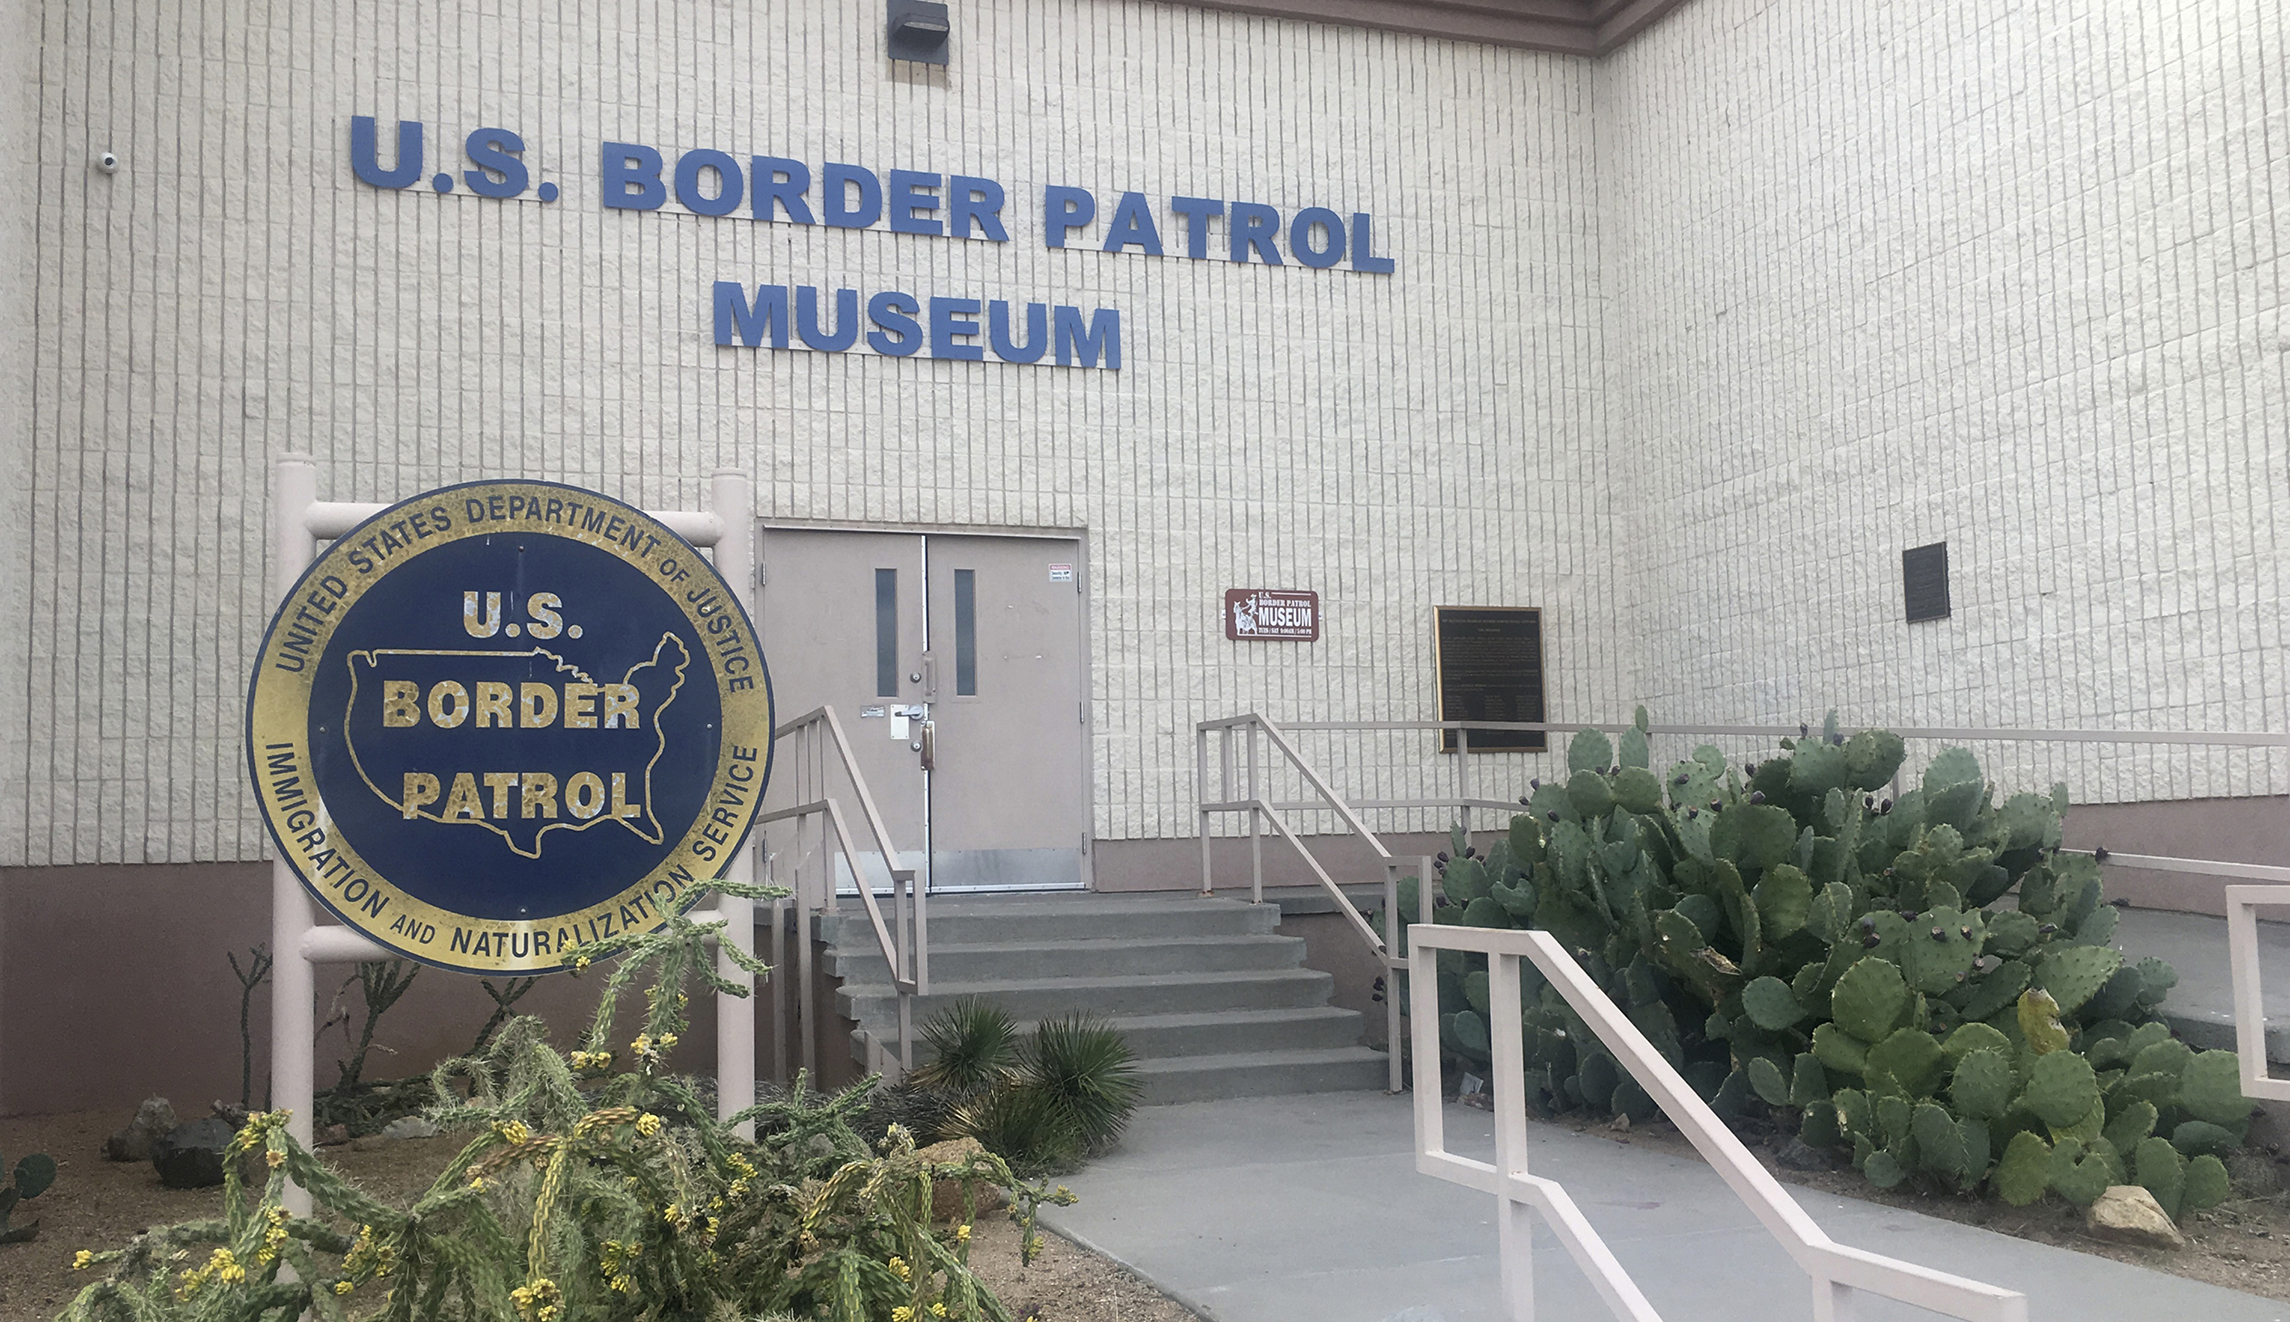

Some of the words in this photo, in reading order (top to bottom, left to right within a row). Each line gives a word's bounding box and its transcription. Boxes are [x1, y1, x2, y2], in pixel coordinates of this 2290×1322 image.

[351, 115, 559, 203] U.S.
[603, 141, 1010, 242] BORDER
[1045, 185, 1395, 274] PATROL
[713, 280, 1121, 370] MUSEUM
[275, 574, 348, 673] UNITED
[348, 506, 452, 574] STATES
[465, 495, 661, 559] DEPARTMENT
[659, 558, 690, 584] OF
[687, 587, 754, 693] JUSTICE
[463, 590, 584, 640] U.S.
[1258, 591, 1271, 599] U.S.
[1258, 599, 1285, 607] BORDER
[1287, 600, 1311, 608] PATROL
[1258, 607, 1312, 627] MUSEUM
[383, 680, 640, 729] BORDER
[403, 771, 641, 819] PATROL
[266, 742, 390, 919] IMMIGRATION
[389, 914, 436, 945] AND
[450, 863, 695, 957] NATURALIZATION
[692, 745, 758, 862] SERVICE
